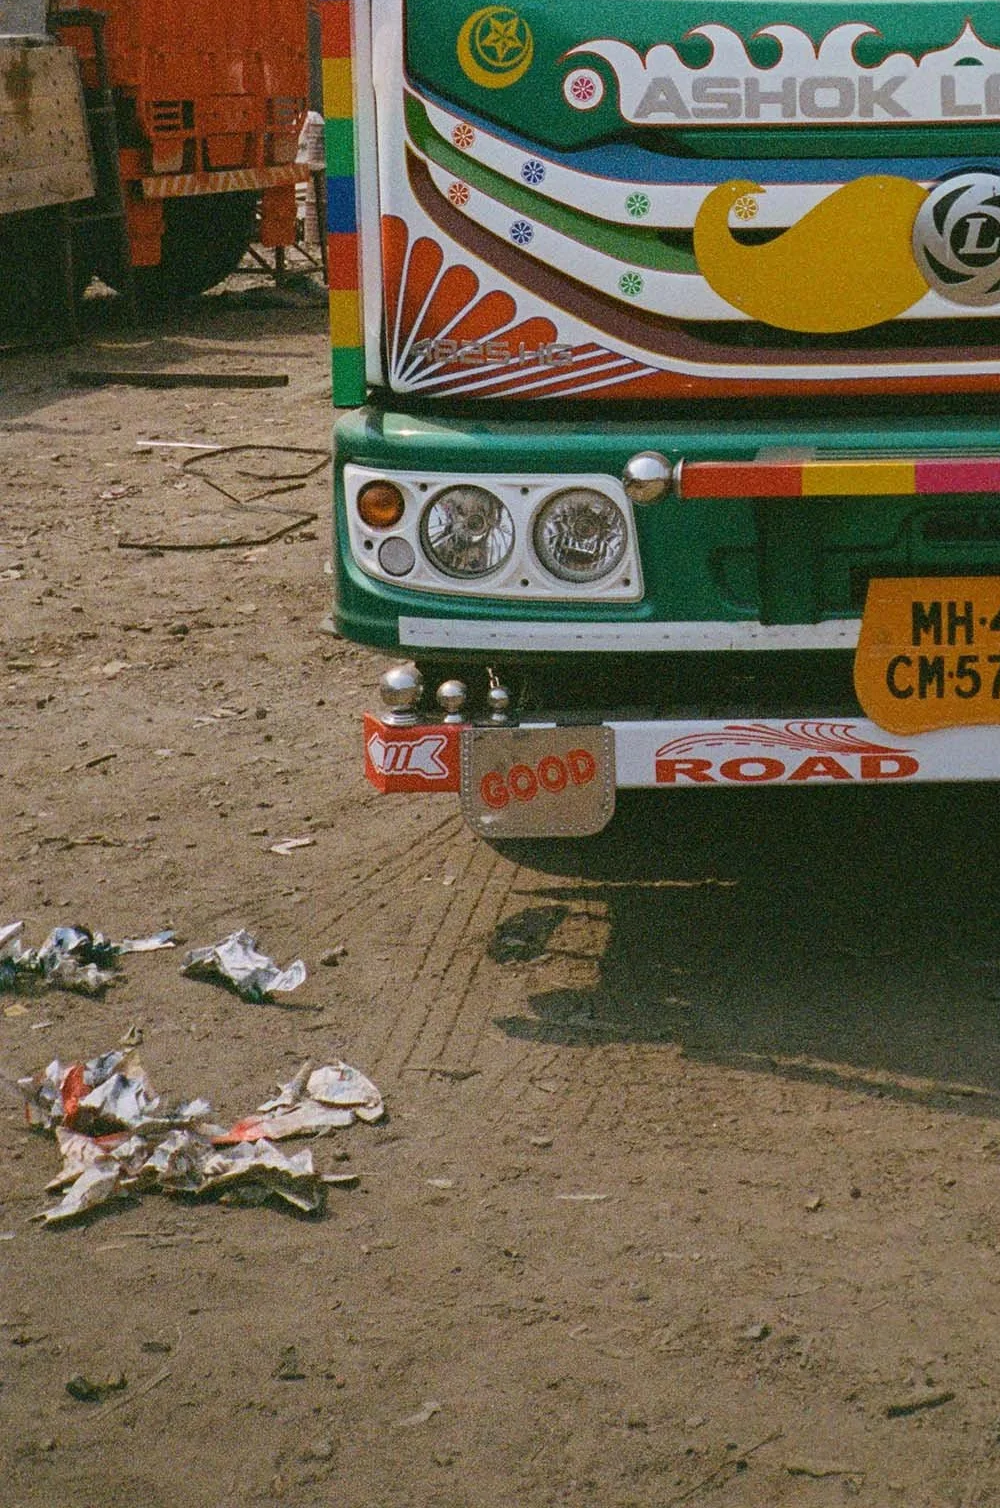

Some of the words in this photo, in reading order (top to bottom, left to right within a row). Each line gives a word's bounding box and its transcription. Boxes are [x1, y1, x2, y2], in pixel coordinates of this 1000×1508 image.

[632, 76, 914, 119] ASHOK
[958, 218, 1000, 255] L
[480, 748, 597, 809] GOOD
[655, 756, 919, 783] ROAD
